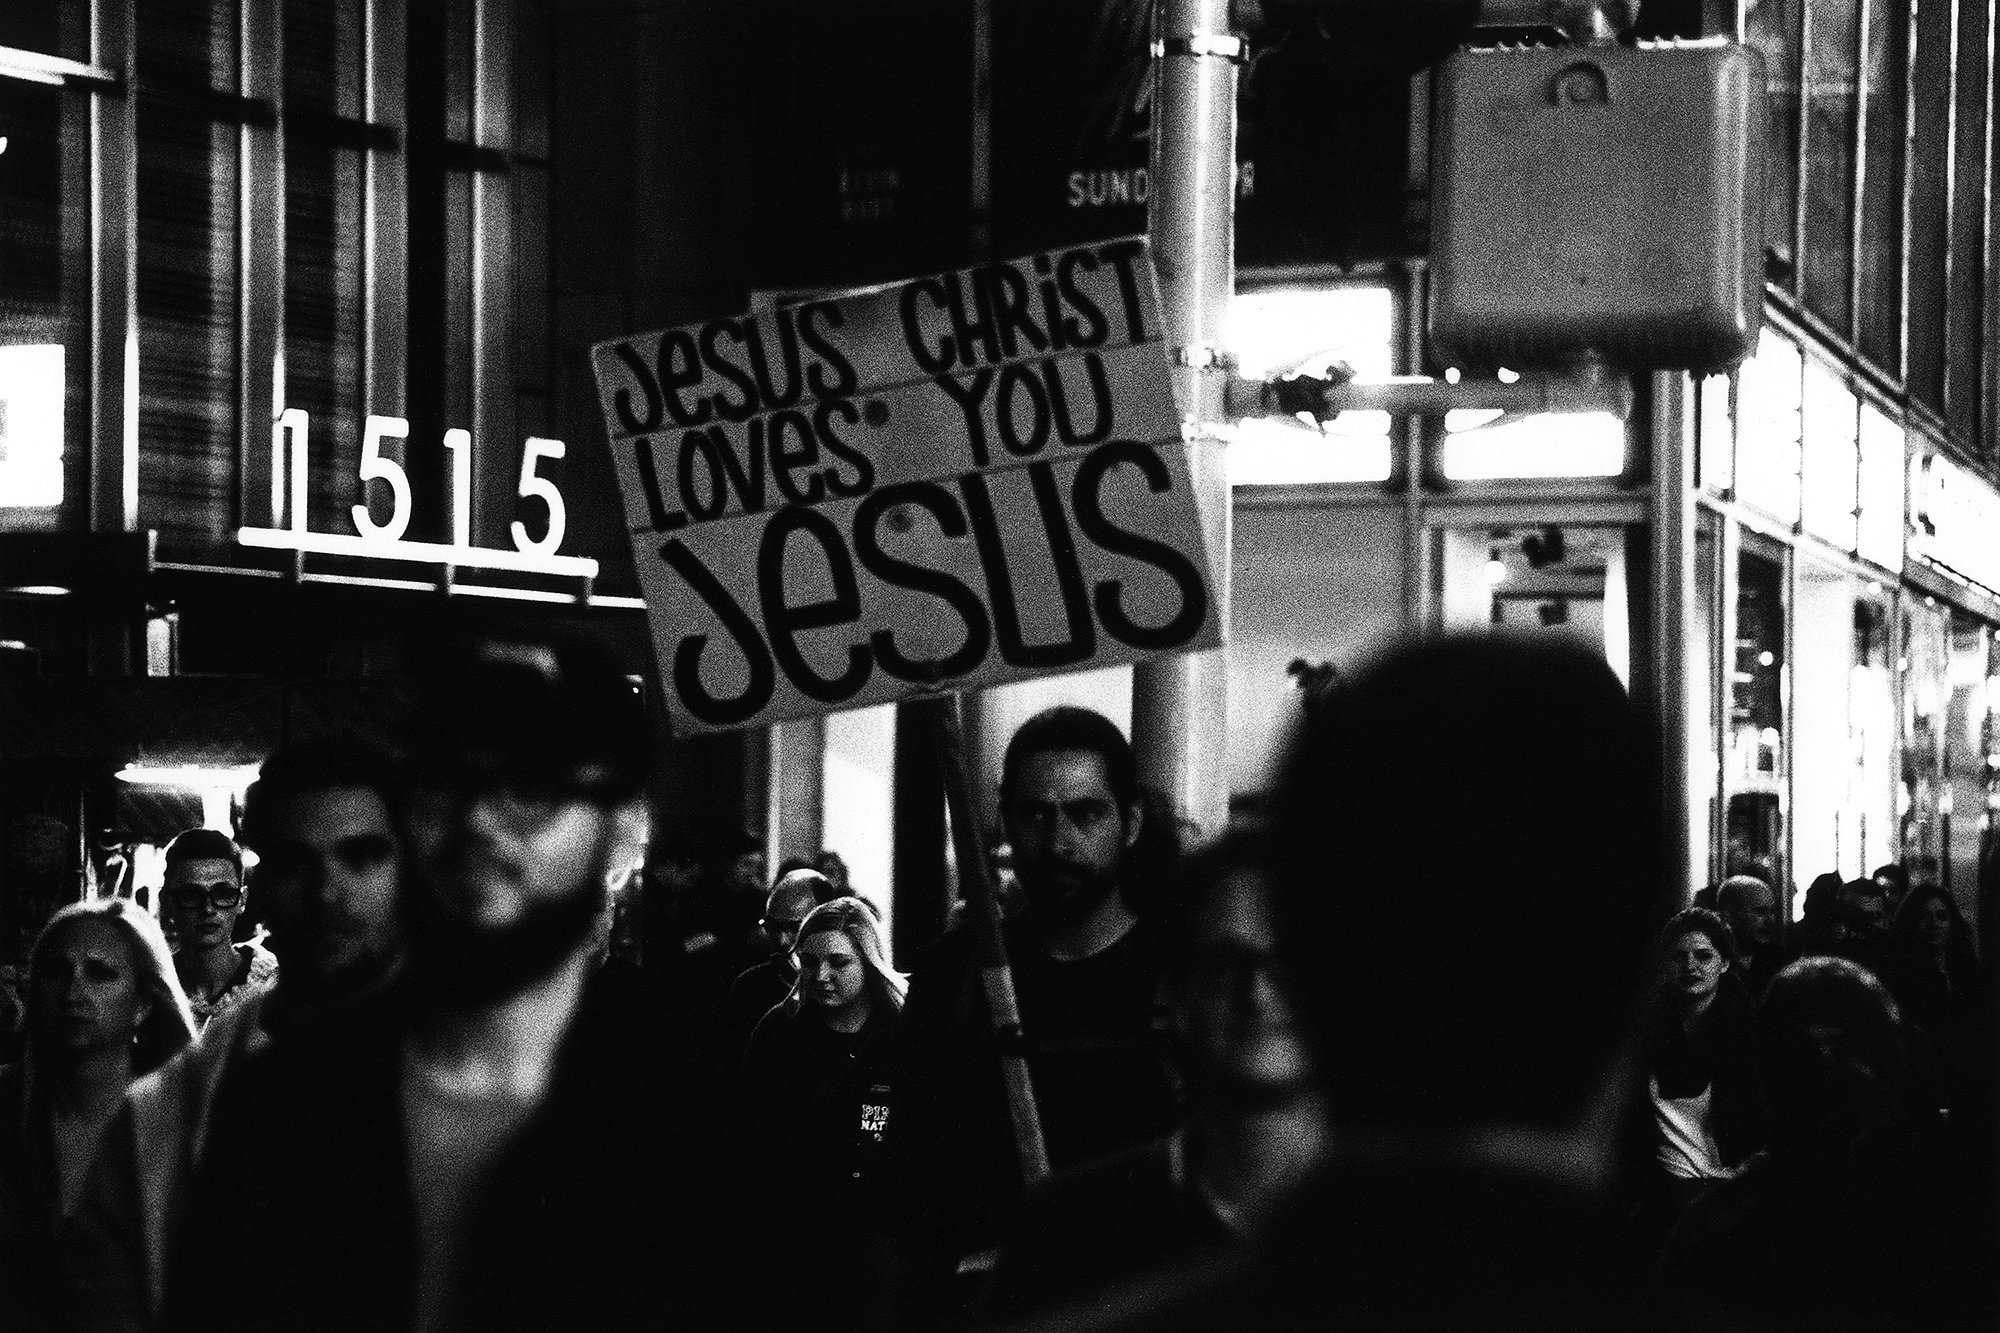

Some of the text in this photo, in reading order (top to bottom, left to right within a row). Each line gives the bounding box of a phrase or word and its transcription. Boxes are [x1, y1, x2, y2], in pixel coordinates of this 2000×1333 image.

[615, 244, 1146, 434] JeSUS CHRiST
[274, 408, 566, 556] 1515
[635, 352, 1114, 532] LOVeS YOU
[658, 440, 1208, 725] JeSUS
